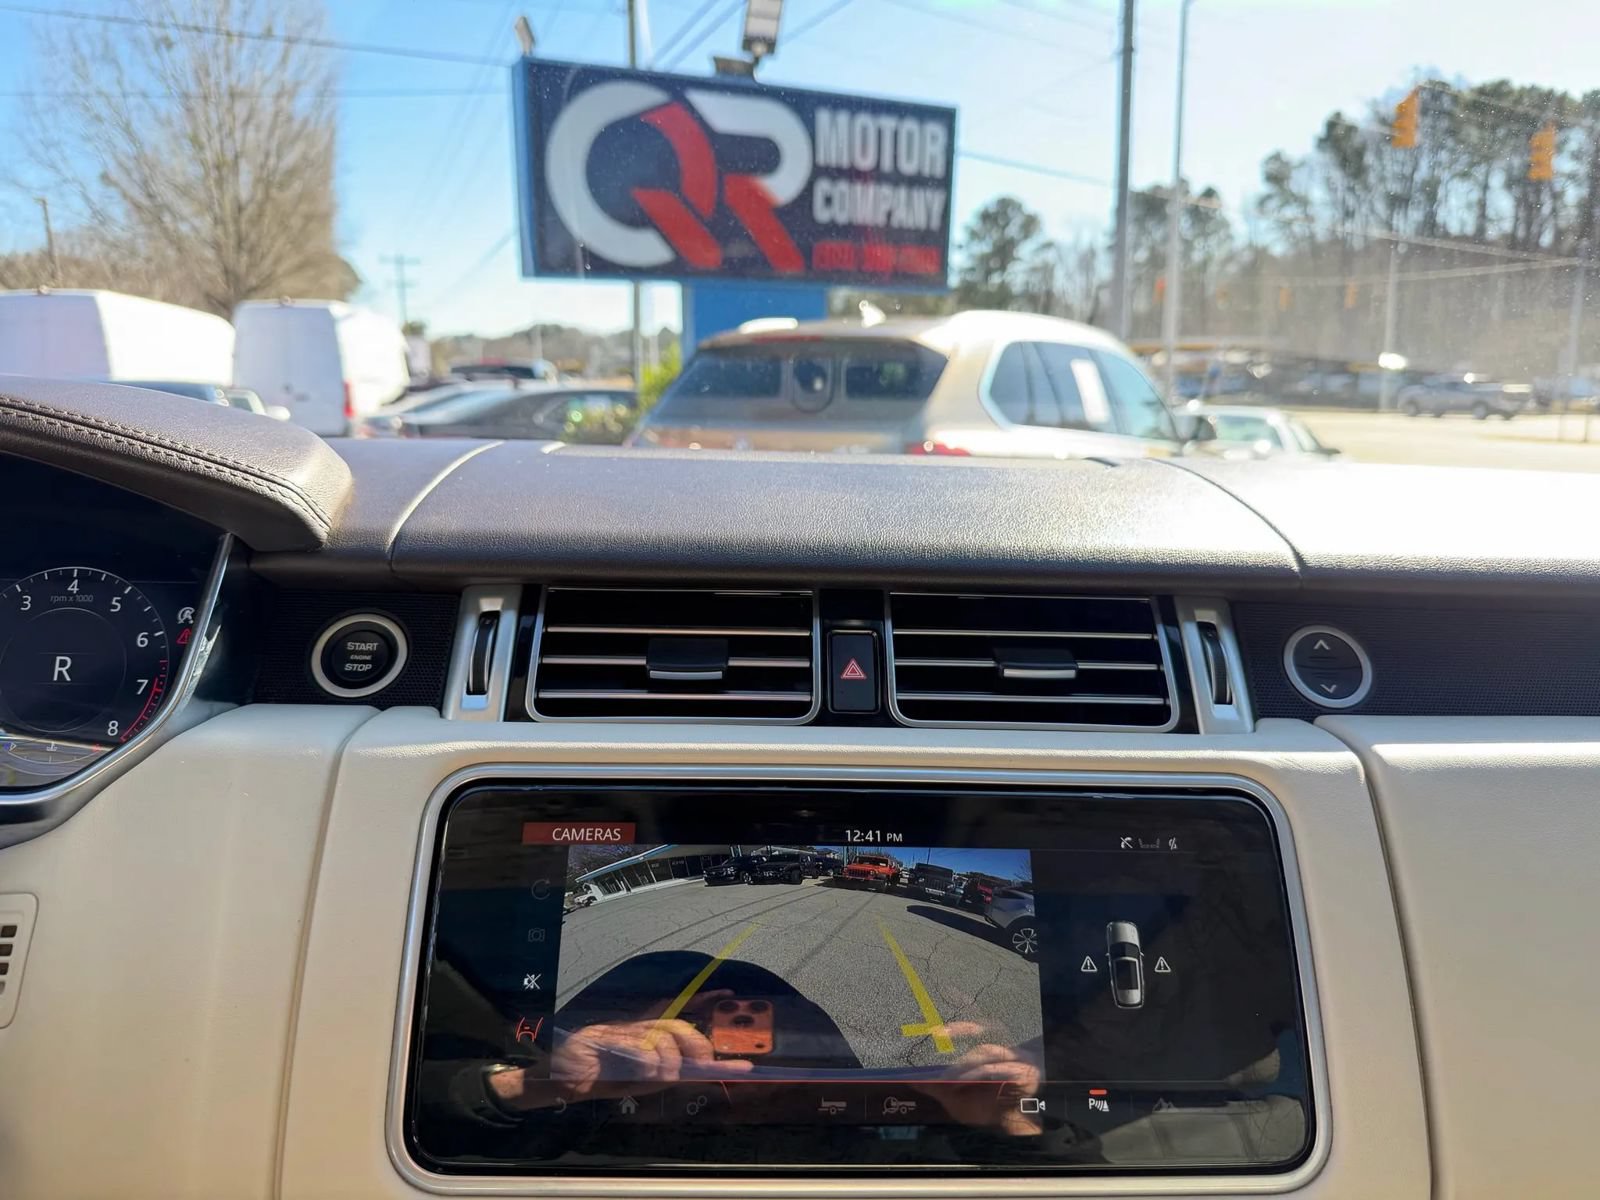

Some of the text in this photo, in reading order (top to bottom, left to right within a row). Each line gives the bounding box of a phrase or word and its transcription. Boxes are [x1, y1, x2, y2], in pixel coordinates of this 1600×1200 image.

[812, 106, 948, 178] MOTOR
[811, 176, 947, 231] COMPANY
[67, 579, 79, 594] 4
[20, 595, 31, 611] 3
[110, 597, 121, 612] 5
[136, 632, 149, 648] 6
[346, 641, 379, 651] START
[53, 656, 72, 682] R
[344, 663, 372, 672] STOP
[136, 679, 148, 695] 7
[107, 720, 119, 737] 8
[552, 828, 621, 841] CAMERAS
[845, 829, 903, 842] 12:41 PM
